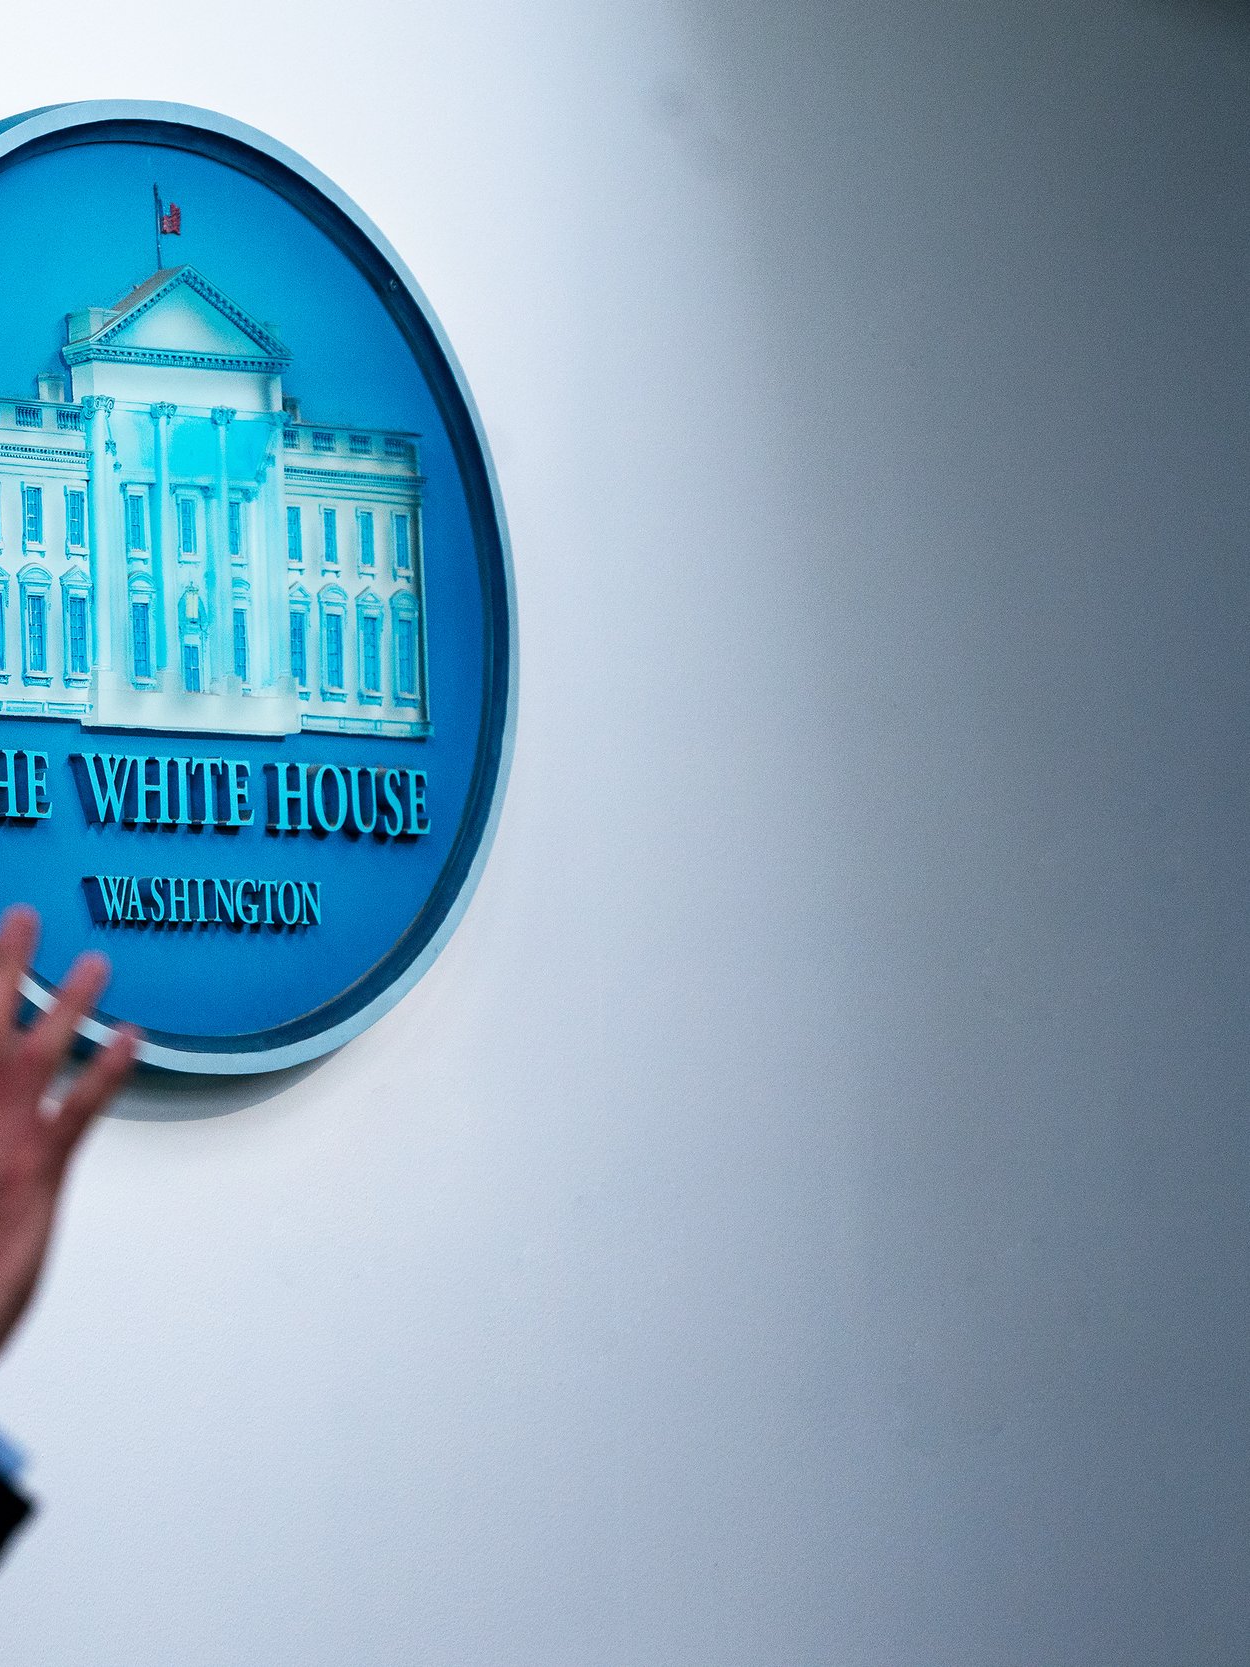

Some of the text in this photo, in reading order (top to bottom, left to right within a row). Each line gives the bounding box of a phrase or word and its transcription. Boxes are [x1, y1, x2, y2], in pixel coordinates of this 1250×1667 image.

[81, 752, 255, 827] WHITE
[274, 762, 432, 837] HOUSE
[95, 875, 323, 926] WASHINGTON
